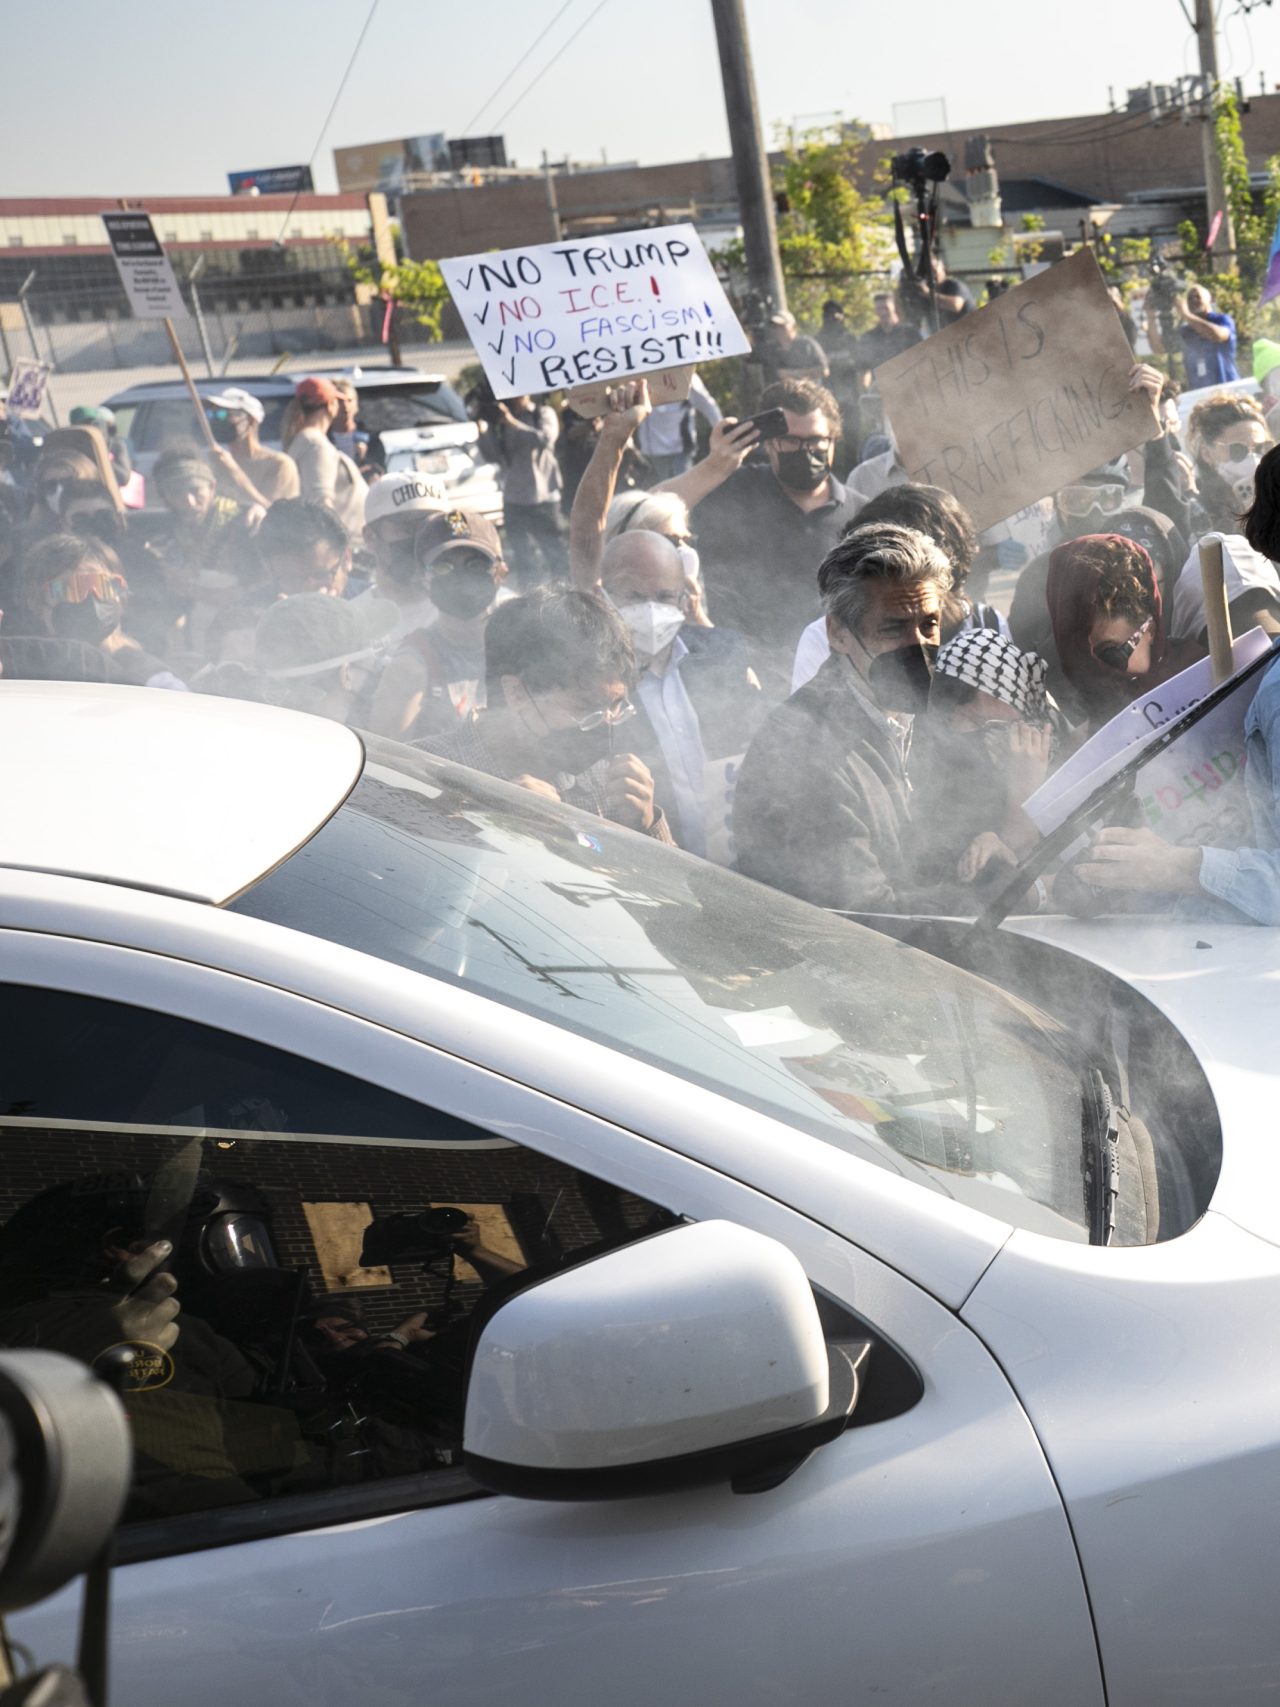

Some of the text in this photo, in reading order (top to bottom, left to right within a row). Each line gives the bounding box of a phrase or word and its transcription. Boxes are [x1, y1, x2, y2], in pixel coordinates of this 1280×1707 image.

[478, 240, 690, 292] NO TRUMP
[499, 296, 542, 326] NO
[514, 329, 556, 354] NO
[540, 331, 724, 387] RESIST!!!
[895, 300, 1045, 416] THIS IS
